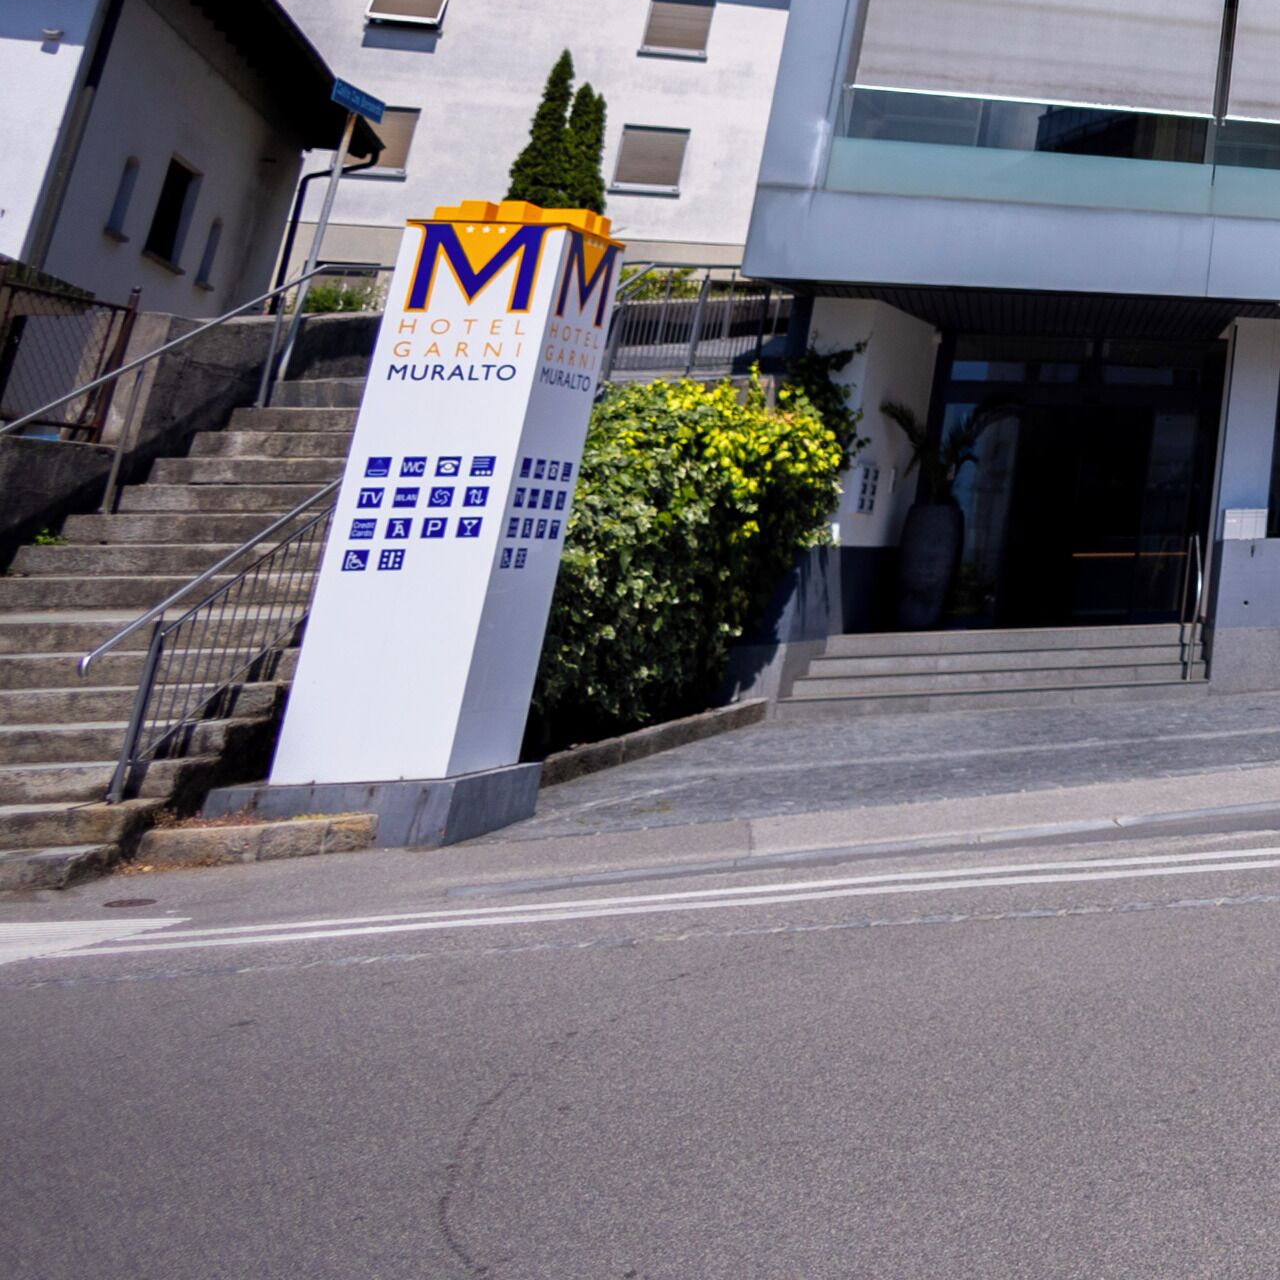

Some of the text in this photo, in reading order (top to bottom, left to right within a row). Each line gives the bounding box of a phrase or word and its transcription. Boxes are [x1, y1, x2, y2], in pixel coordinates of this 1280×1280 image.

[403, 223, 552, 314] M
[554, 230, 620, 329] M
[397, 318, 526, 336] HOTEL
[550, 323, 599, 350] HOTEL
[392, 341, 522, 358] GARNI
[544, 345, 597, 370] GARNI
[386, 364, 517, 381] MURALTO
[539, 366, 591, 393] MURALTO
[403, 461, 425, 474] WC
[361, 491, 383, 504] TV
[426, 520, 442, 537] P
